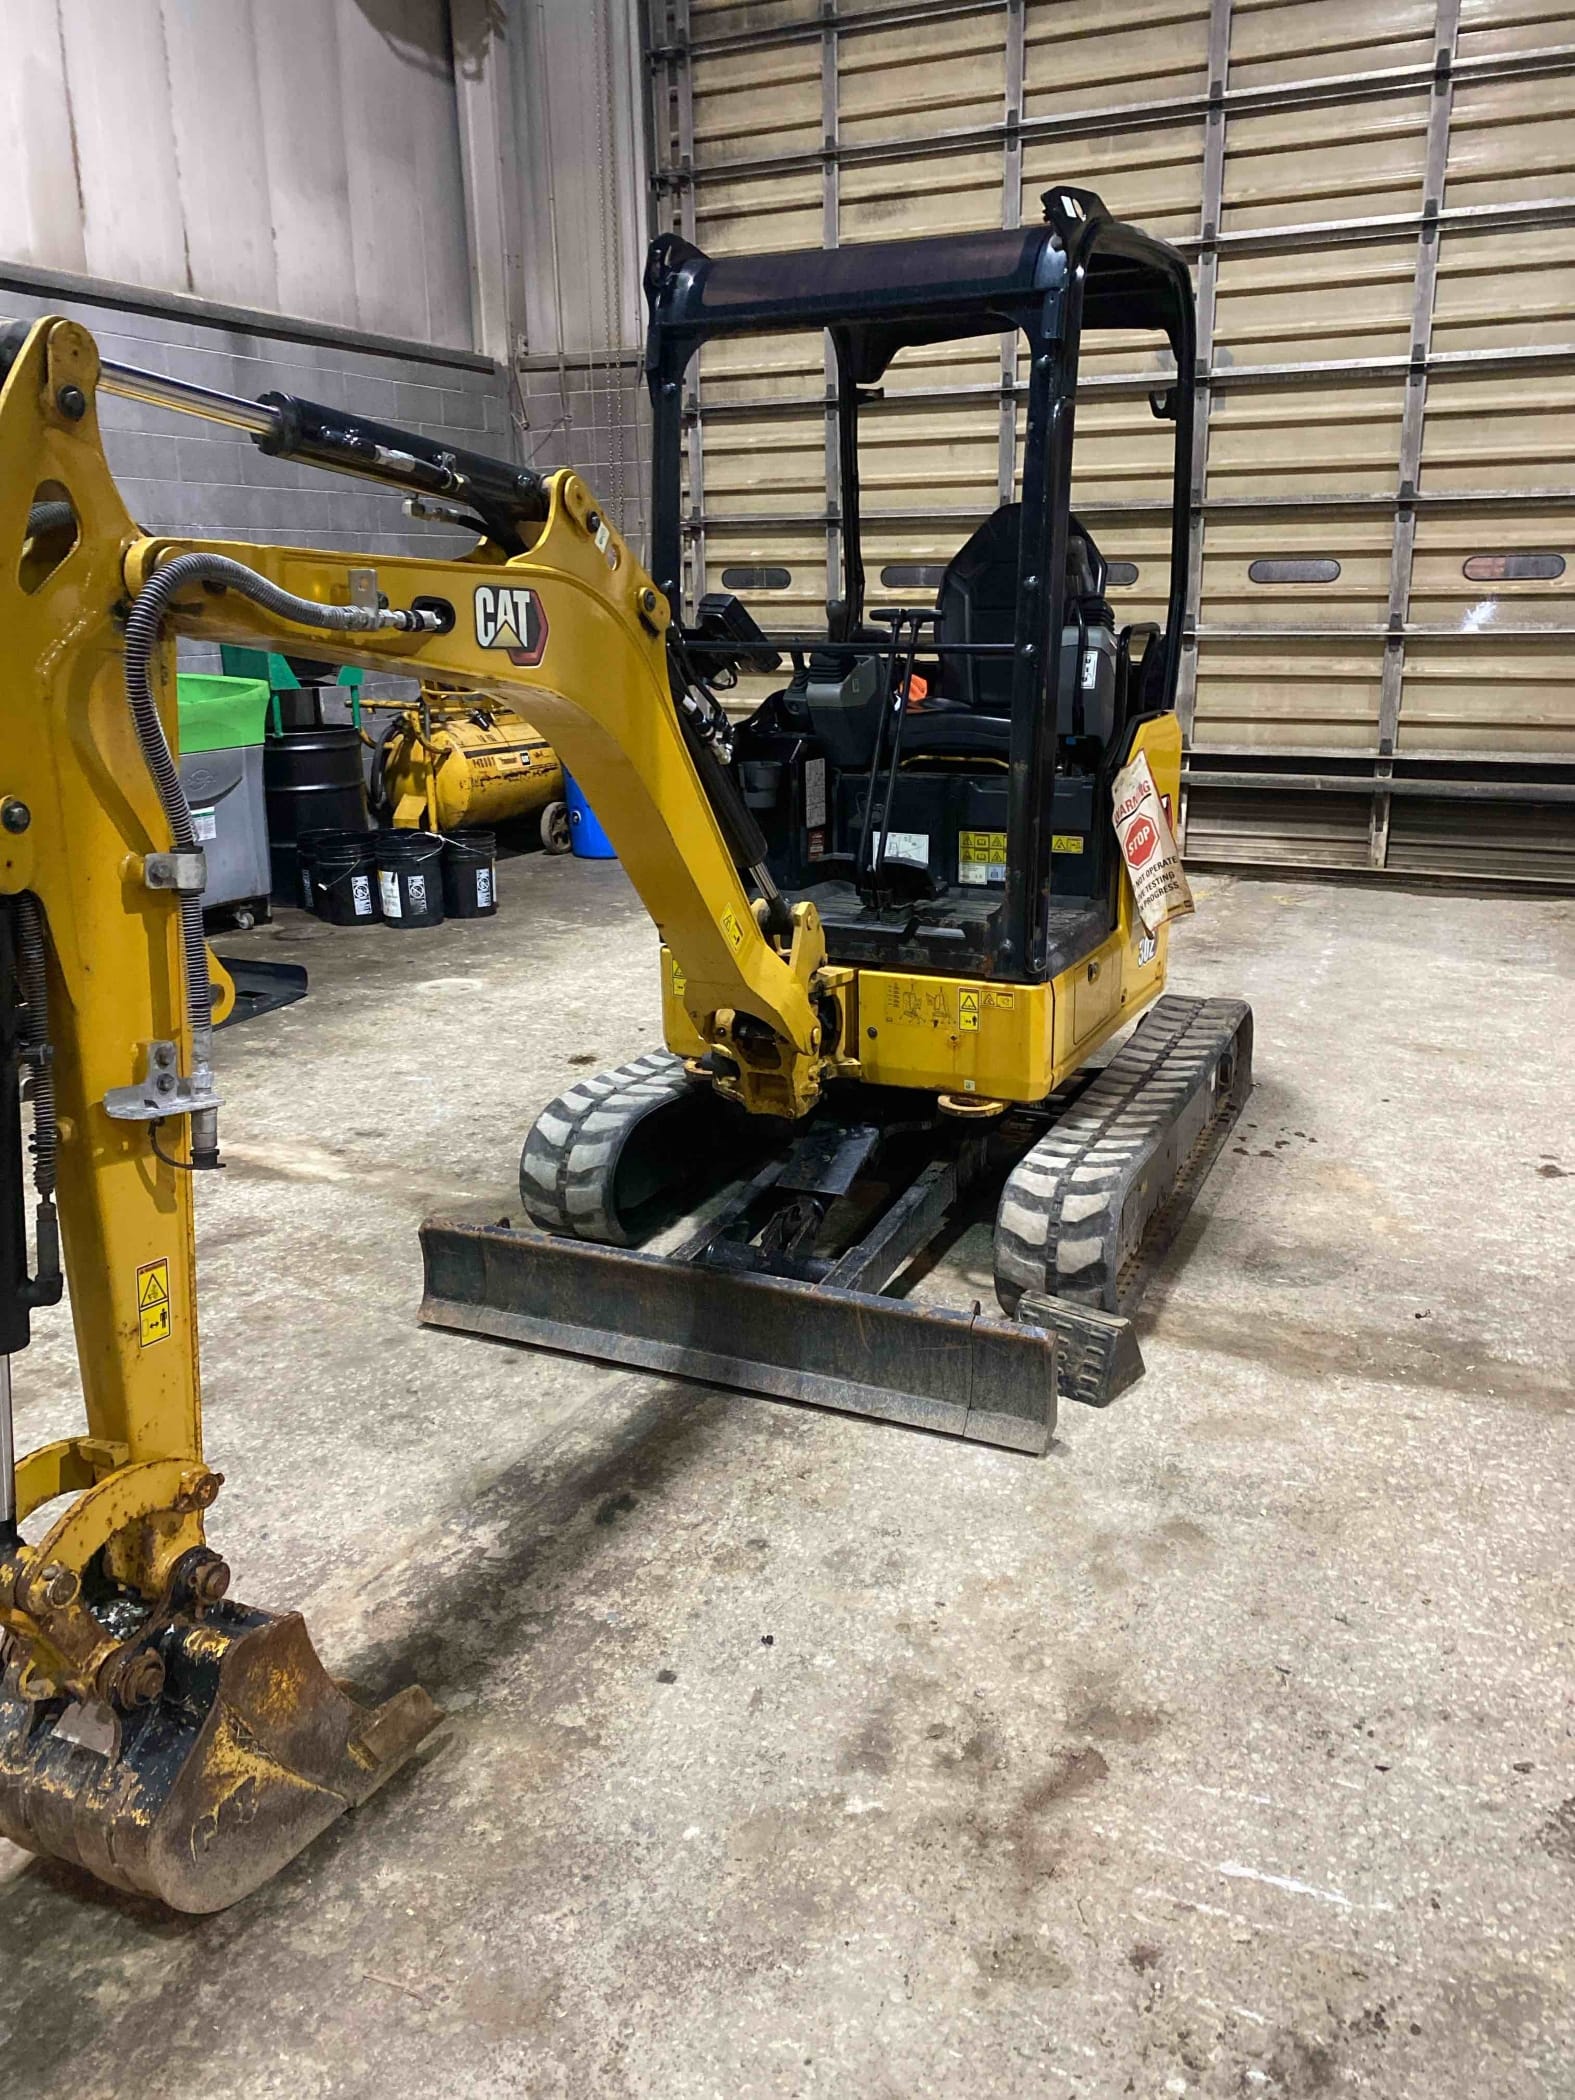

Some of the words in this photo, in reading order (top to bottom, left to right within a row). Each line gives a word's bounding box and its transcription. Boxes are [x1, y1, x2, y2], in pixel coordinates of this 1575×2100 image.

[475, 586, 531, 648] CAT
[1114, 780, 1151, 824] WARNNG
[1128, 825, 1151, 857] STOP
[1135, 873, 1146, 887] NOT
[1145, 855, 1178, 878] OPERATE
[1145, 870, 1176, 893] TESTING
[1143, 880, 1180, 908] PROGRESS
